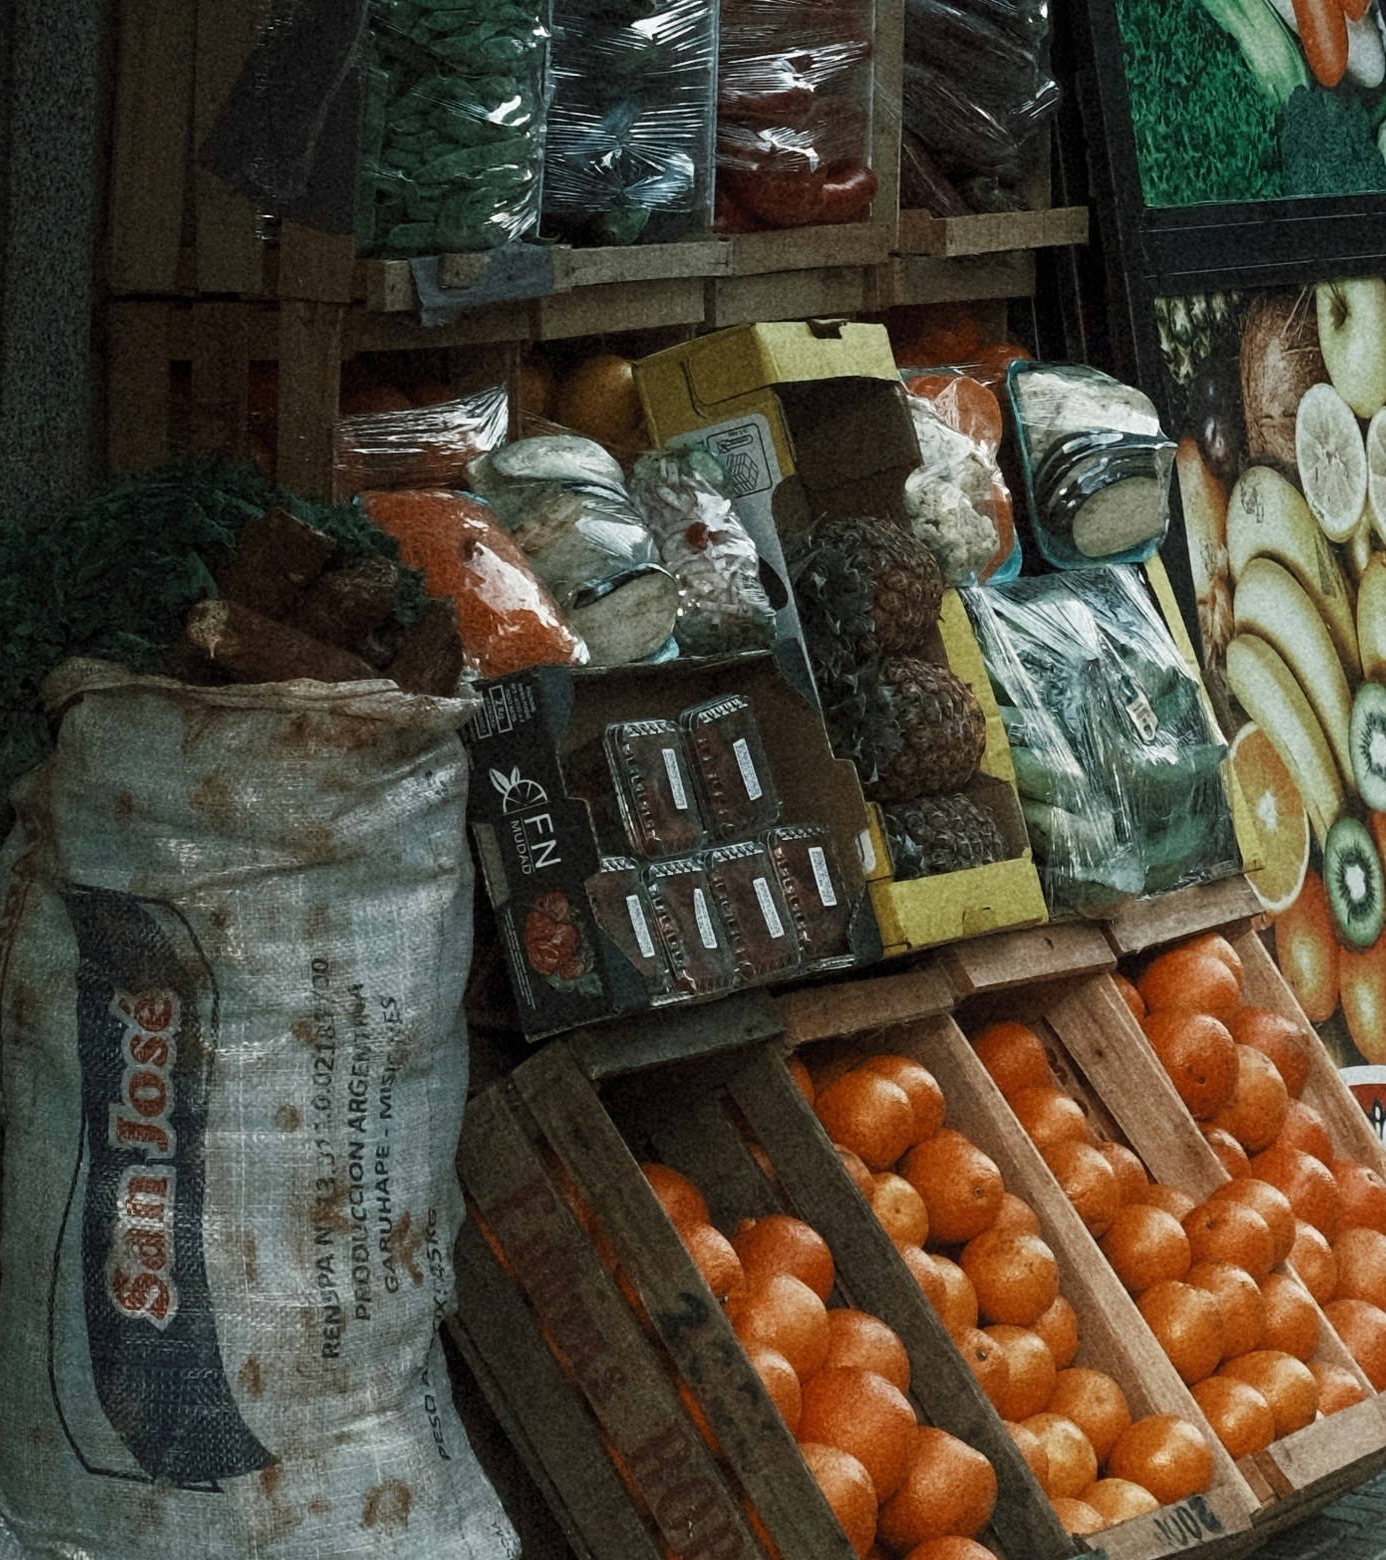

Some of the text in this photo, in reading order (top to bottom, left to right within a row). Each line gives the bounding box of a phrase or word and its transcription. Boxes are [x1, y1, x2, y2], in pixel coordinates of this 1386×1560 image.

[510, 818, 533, 876] MUDAD
[524, 812, 562, 870] FN
[109, 988, 175, 1326] San José
[349, 1142, 371, 1322] PRODUCCION
